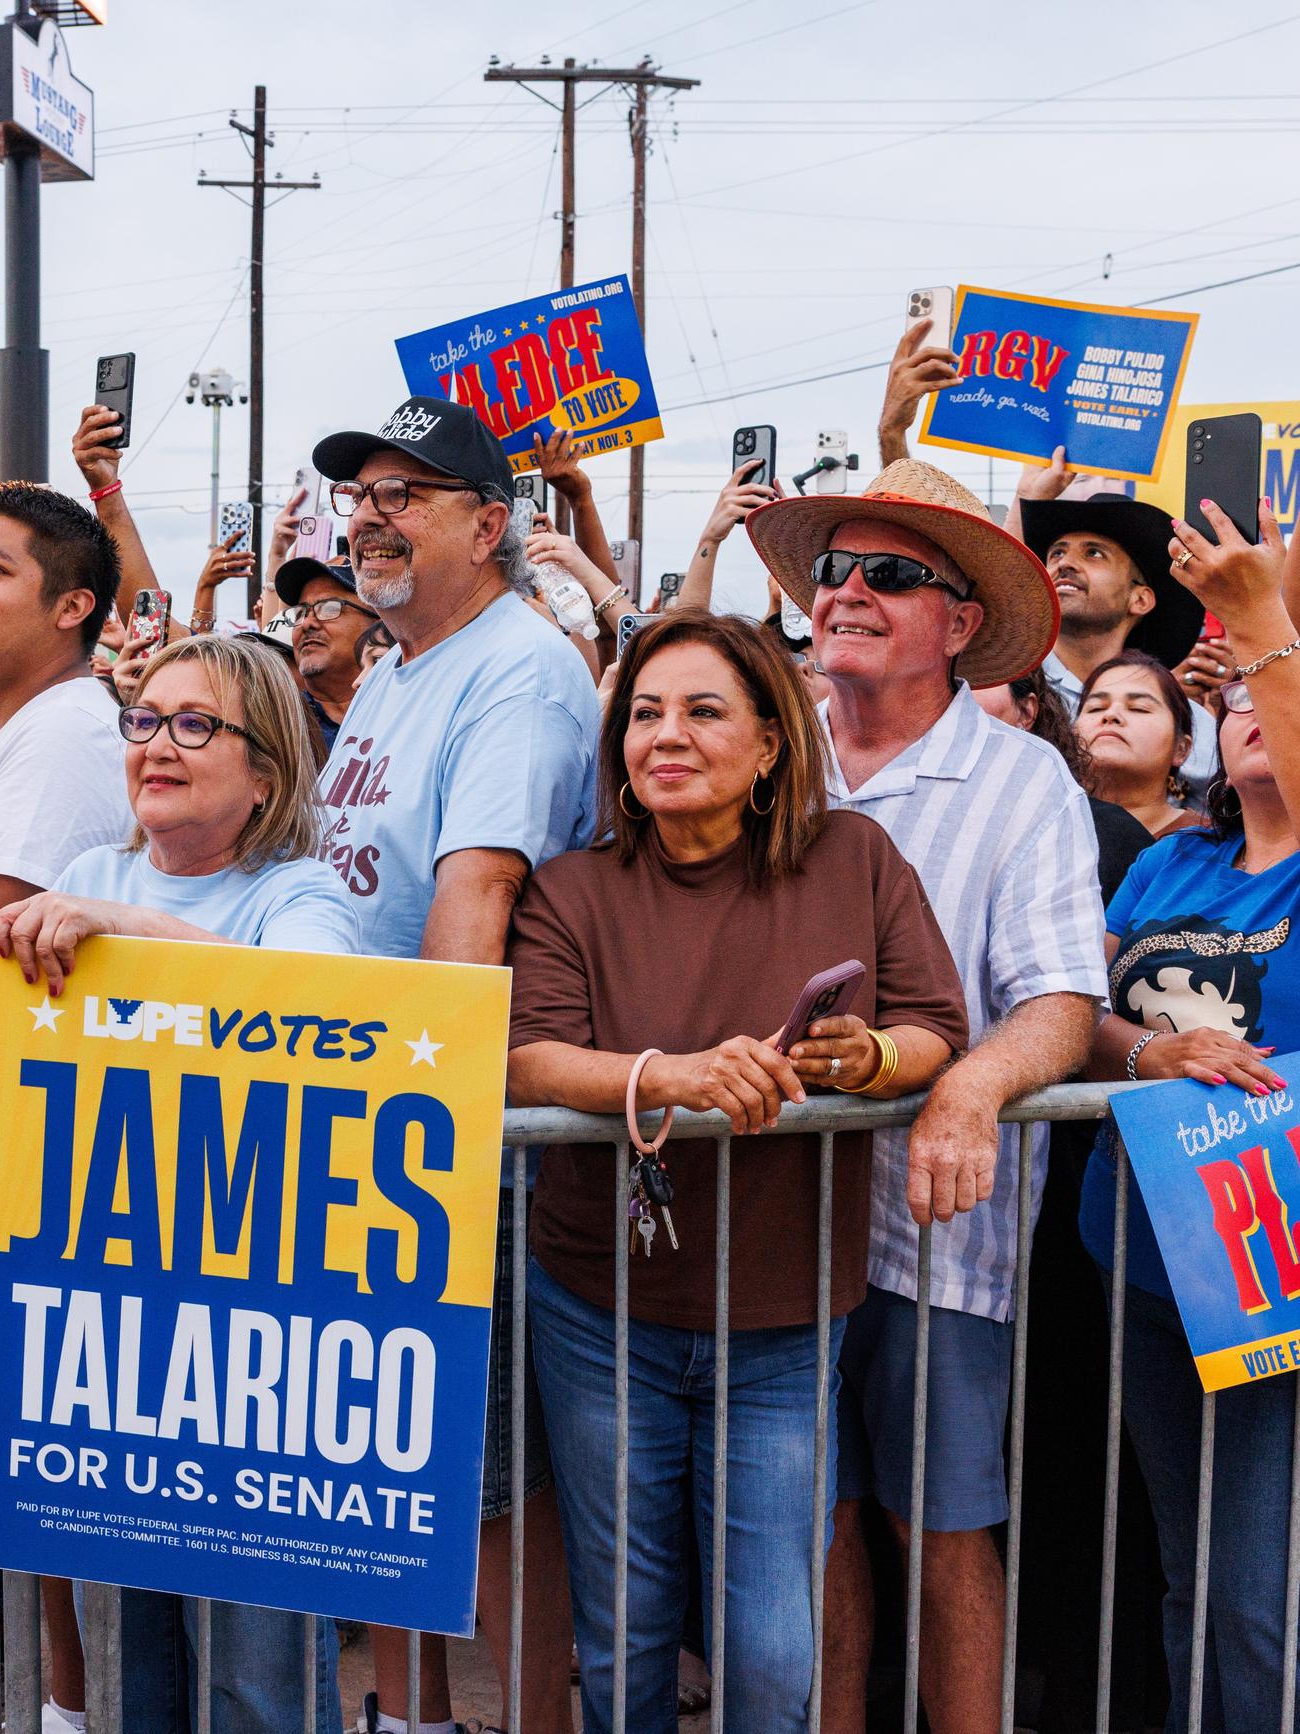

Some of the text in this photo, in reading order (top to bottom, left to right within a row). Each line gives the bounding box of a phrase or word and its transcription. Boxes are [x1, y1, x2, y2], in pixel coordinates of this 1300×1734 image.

[31, 71, 77, 131] MUSTANG
[36, 107, 74, 157] LOUNGE
[550, 281, 624, 311] VOTOLATINO.ORG
[429, 324, 497, 372] take the
[958, 330, 1070, 393] RGV
[1083, 345, 1165, 370] BOBBY PULIDO
[1066, 379, 1164, 407] JAMES TALARICO
[1076, 363, 1163, 389] GINA HINOJOSA
[562, 381, 628, 427] TO VOTE
[1073, 400, 1150, 417] VOTE EARLY
[1076, 411, 1142, 431] VOTOLATINO.ORG
[597, 432, 623, 449] NOV.
[625, 430, 634, 443] 3
[83, 995, 388, 1062] LUPE VOTES
[1177, 1087, 1294, 1157] take the
[9, 1058, 456, 1306] JAMES
[12, 1282, 436, 1473] TALARICO
[1241, 1344, 1289, 1378] VOTE
[9, 1438, 436, 1535] FOR U.S. SENATE
[16, 1501, 429, 1568] PAID FOR BY LUPE VOTES FEDERAL SUPER PAC. NOT AUTHORIZED BY ANY CANDIDATE
[40, 1519, 401, 1579] OR CANDIDATE'S COMMITTEE. 1601 U.S. BUSINESS 83, SAN JUAN, TX 78589
